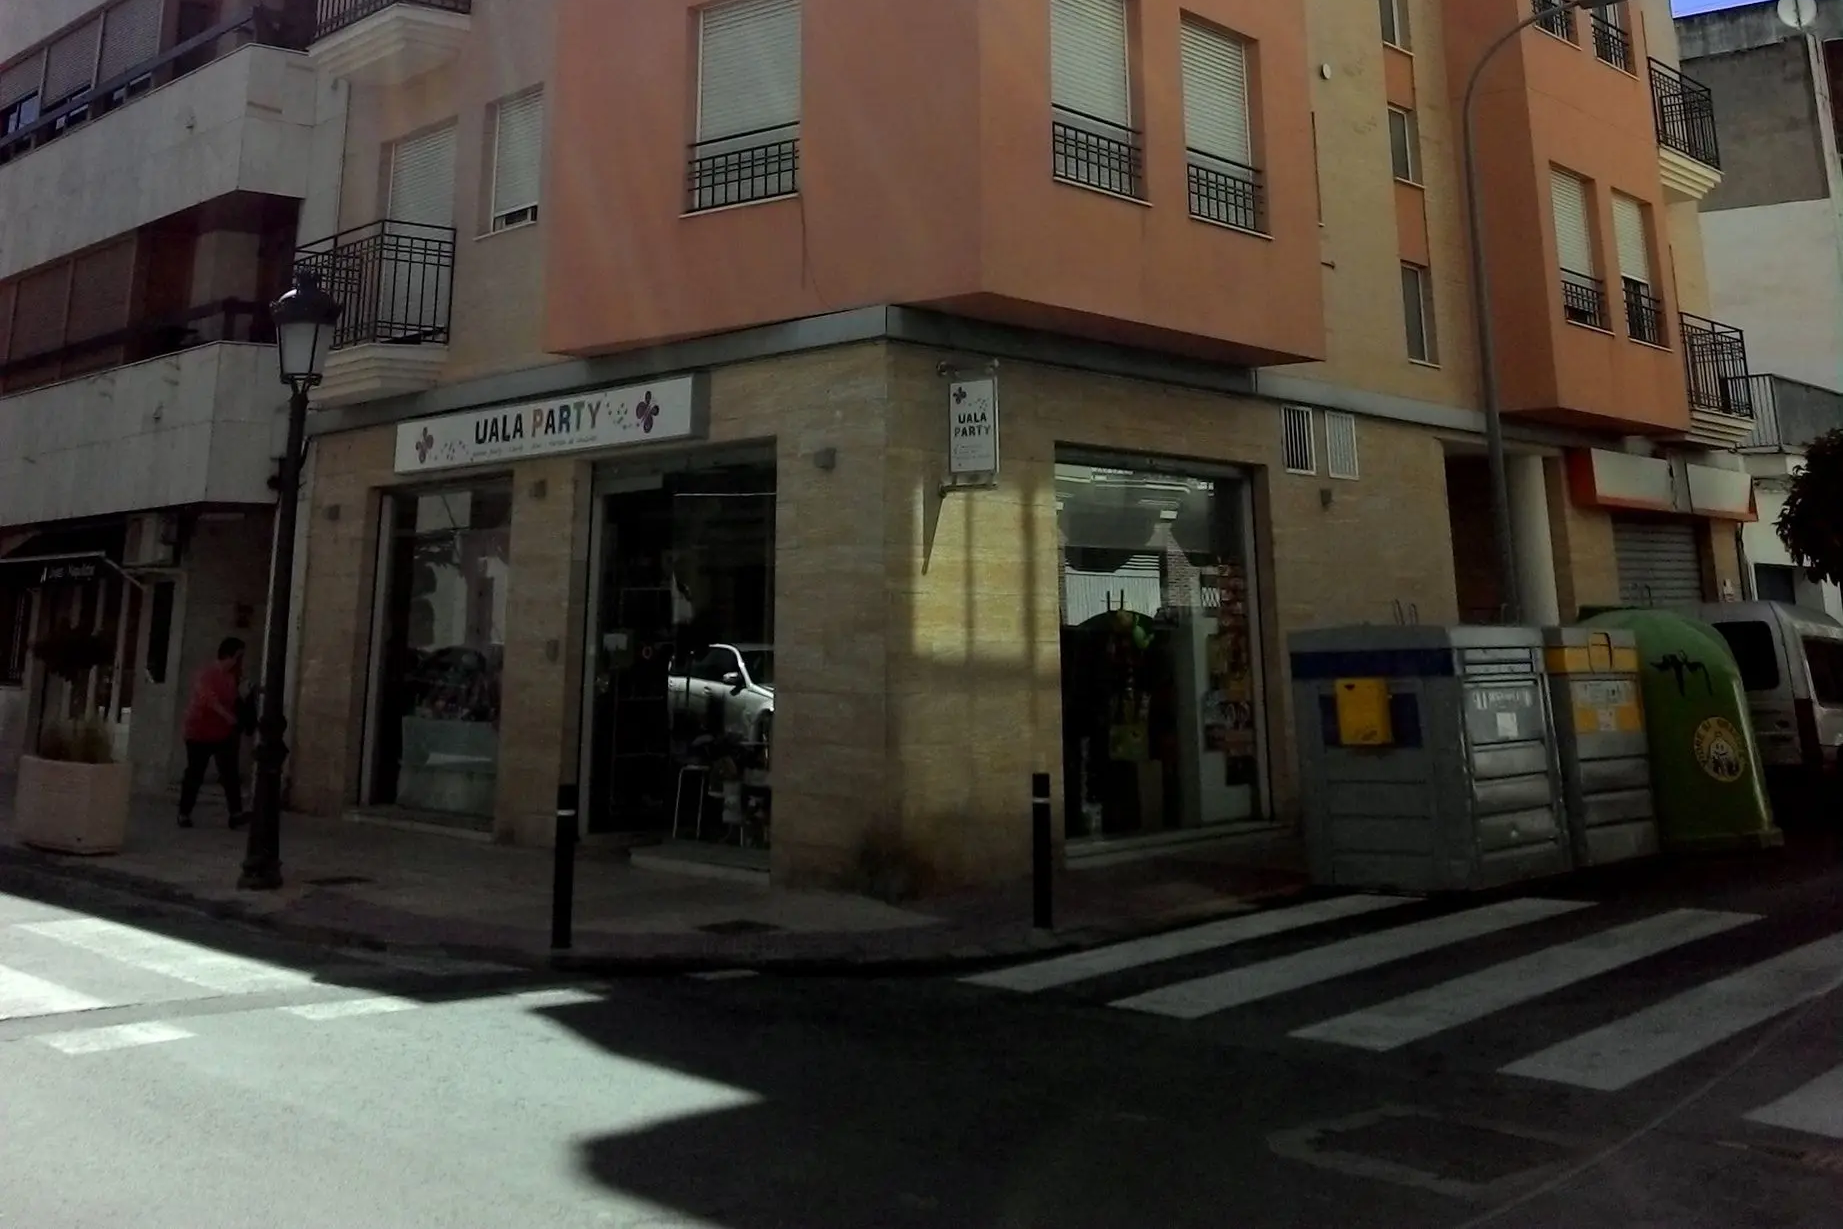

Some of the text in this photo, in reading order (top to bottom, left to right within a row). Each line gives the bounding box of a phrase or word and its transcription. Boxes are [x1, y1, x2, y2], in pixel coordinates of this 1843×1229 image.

[475, 400, 601, 445] UALA PARTY
[958, 412, 987, 424] UALA
[954, 424, 991, 437] PARTY
